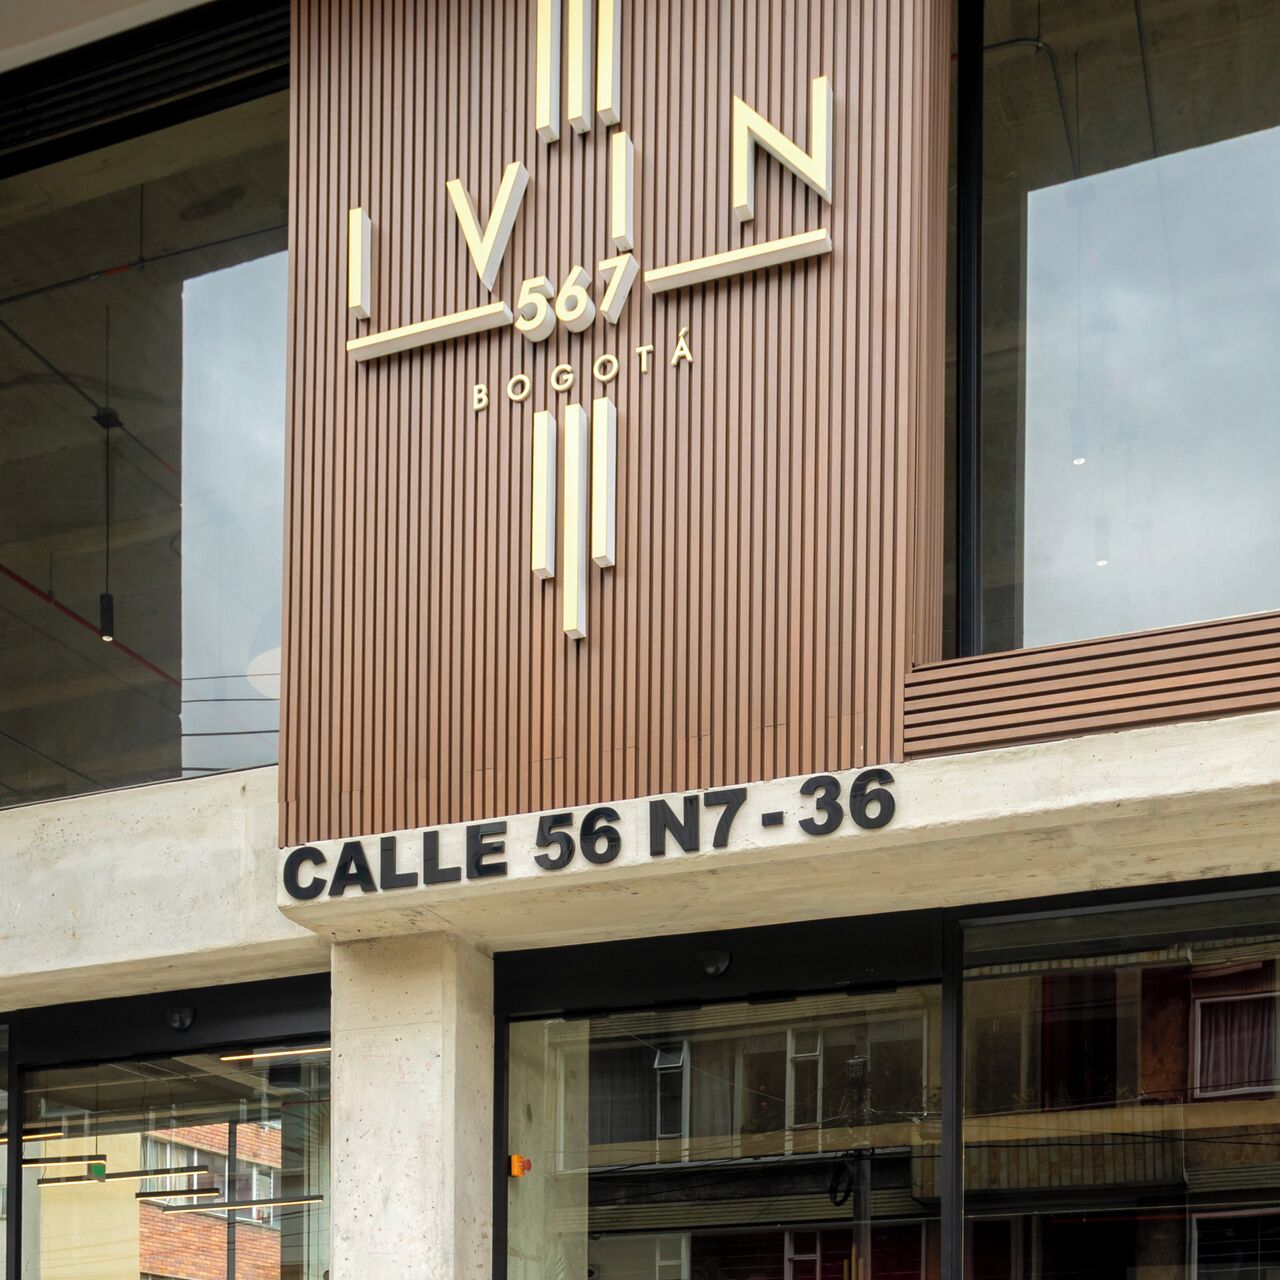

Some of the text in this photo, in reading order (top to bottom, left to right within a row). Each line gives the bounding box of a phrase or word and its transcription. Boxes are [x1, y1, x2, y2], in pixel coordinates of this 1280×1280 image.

[348, 76, 833, 320] IVIN
[515, 254, 639, 342] 567
[472, 328, 695, 412] BOGOTÁ
[283, 821, 508, 900] CALLE
[534, 807, 622, 870] 56
